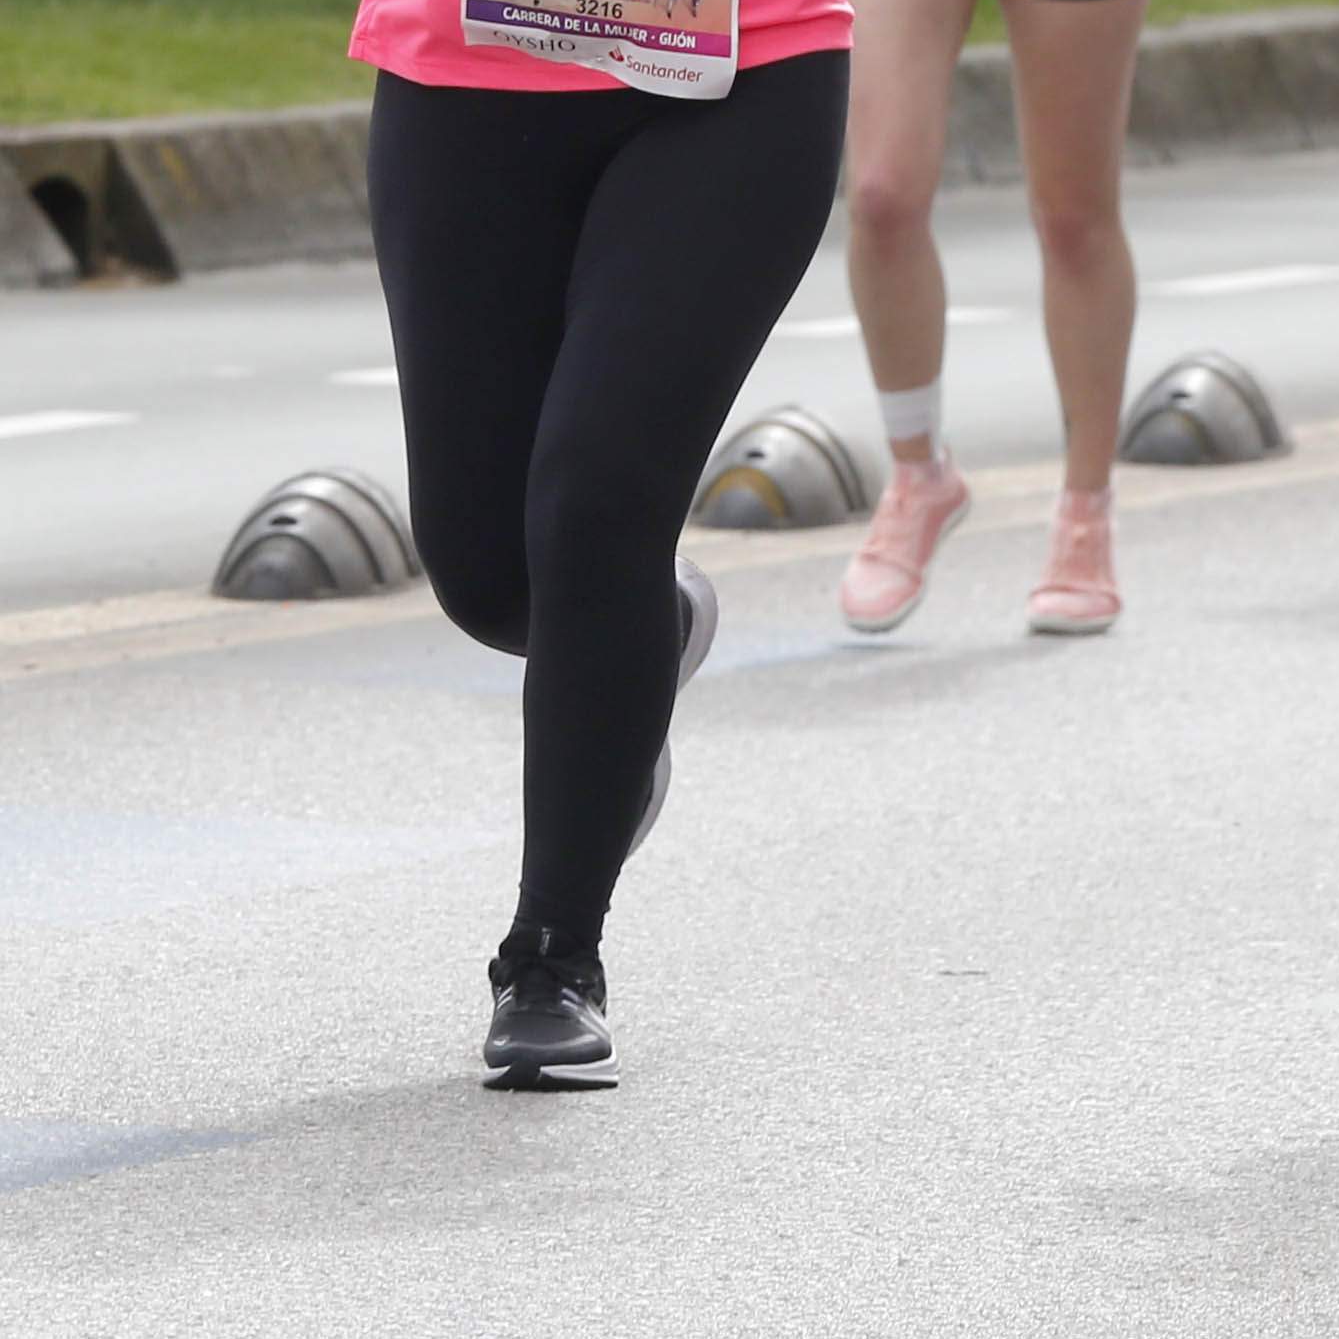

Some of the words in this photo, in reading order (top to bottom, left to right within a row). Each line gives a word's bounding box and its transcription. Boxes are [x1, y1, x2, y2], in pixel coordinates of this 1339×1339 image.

[493, 30, 576, 52] OYSHO
[502, 7, 560, 29] CARRERA
[565, 17, 580, 31] DE
[584, 19, 601, 34] LA
[604, 24, 648, 42] MUJER
[659, 28, 696, 48] GIJÓN
[626, 54, 703, 83] Santander
